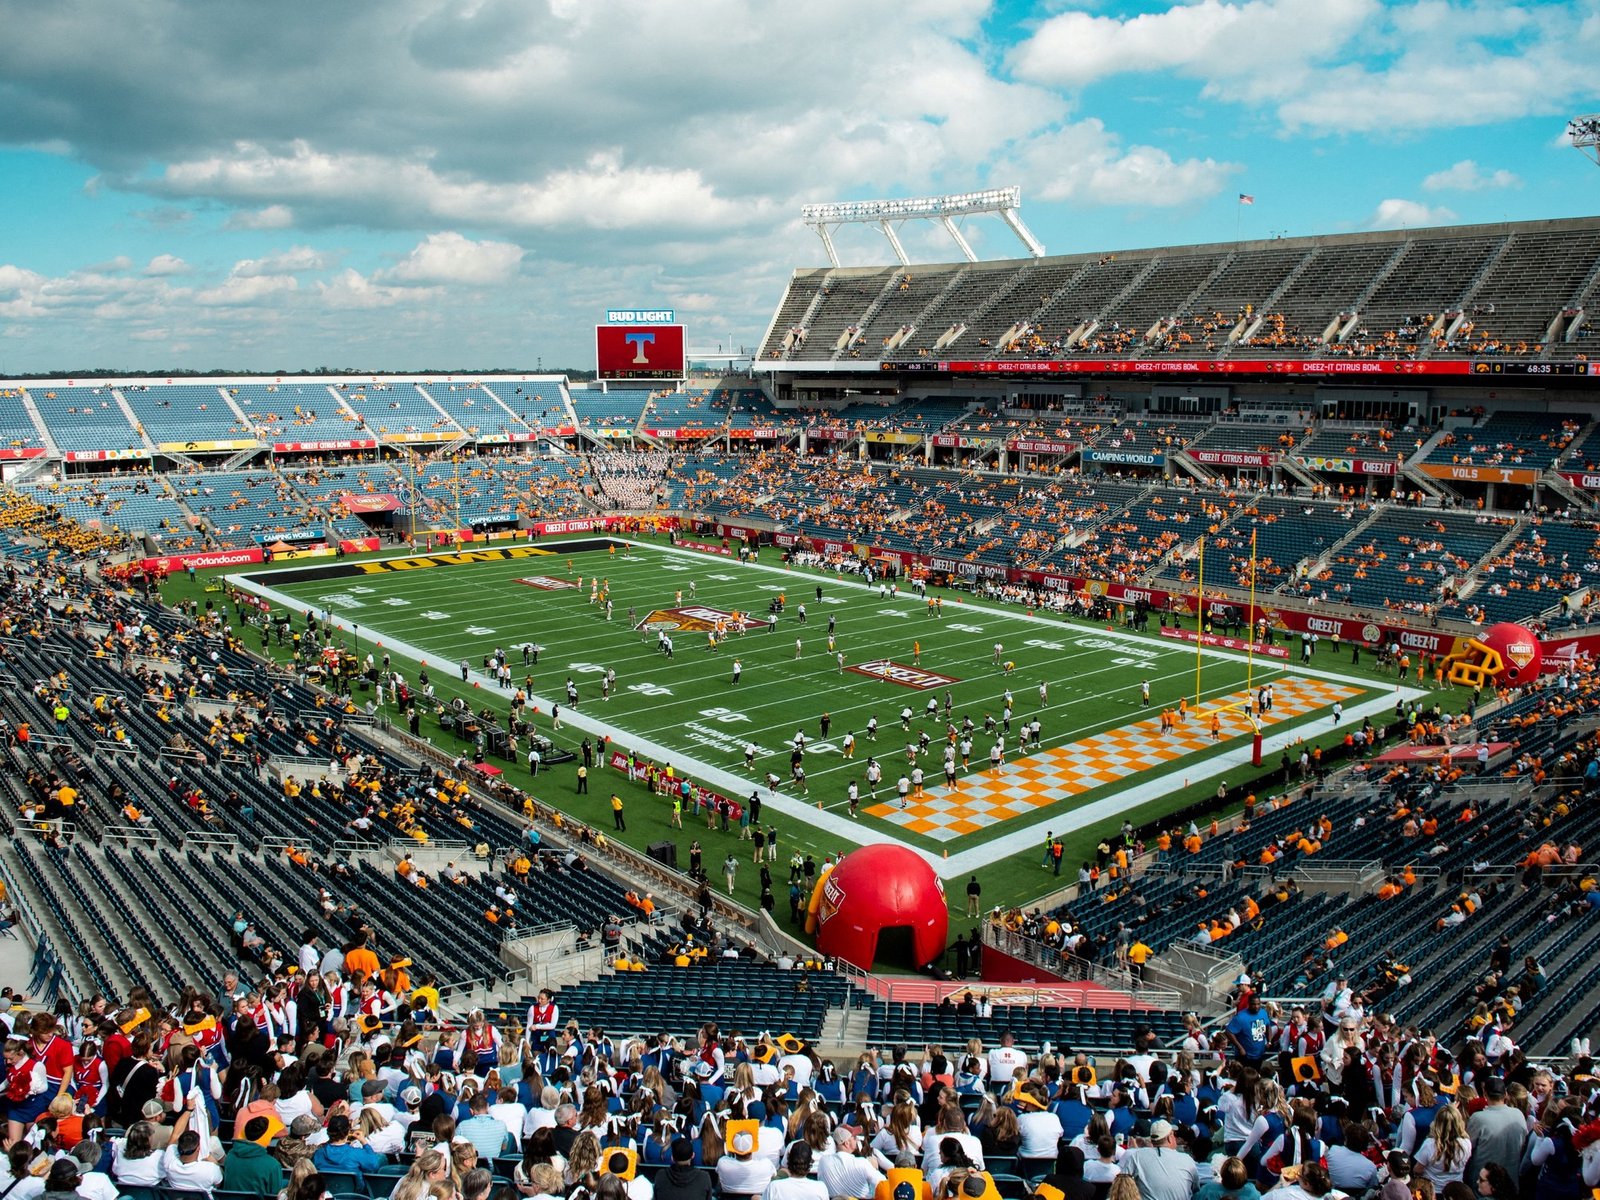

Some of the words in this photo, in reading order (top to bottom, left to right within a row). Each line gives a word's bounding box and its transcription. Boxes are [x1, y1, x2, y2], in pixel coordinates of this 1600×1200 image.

[608, 311, 635, 322] BUD
[636, 311, 673, 322] LIGHT
[625, 333, 656, 363] T
[1037, 363, 1050, 371] BOWL
[1183, 363, 1199, 371] BOWL
[1303, 363, 1335, 371] CHEEZ-IT
[1336, 363, 1360, 371] CITRUS
[1362, 364, 1382, 372] BOWL
[1495, 364, 1501, 372] 0
[1527, 364, 1551, 373] 68:35
[1579, 365, 1585, 373] 0
[656, 430, 677, 438] CHEEZ-IT
[753, 429, 773, 438] CHEEZ-IT
[1016, 442, 1034, 451] CHEEZ-IT
[1035, 444, 1050, 452] CITRUS
[1051, 445, 1066, 453] BOWL
[1092, 451, 1125, 462] CAMPING
[1125, 454, 1154, 464] WORLD
[1198, 452, 1220, 461] CHEEZ-IT
[1221, 454, 1243, 463] CITRUS
[1244, 456, 1263, 465] BOWL
[1362, 461, 1392, 474] CHEEZ-IT
[1452, 468, 1478, 479] VOLS
[1500, 469, 1514, 483] T
[392, 505, 428, 516] Allsate
[468, 516, 492, 524] CAMPING
[545, 522, 567, 533] CHEEZ-IT
[568, 521, 589, 531] CITRUS
[263, 533, 292, 542] CAMPING
[292, 531, 315, 539] WORLD
[353, 547, 558, 575] IOWA
[930, 557, 956, 574] CHEEZ-IT
[1043, 575, 1070, 592] CHEEZ-IT
[1307, 616, 1343, 635] CHEEZ-IT
[1401, 631, 1440, 651] CHEEZ-IT
[627, 682, 671, 696] 30
[698, 707, 748, 723] 20
[732, 738, 776, 757] WLD
[824, 962, 834, 971] 16
